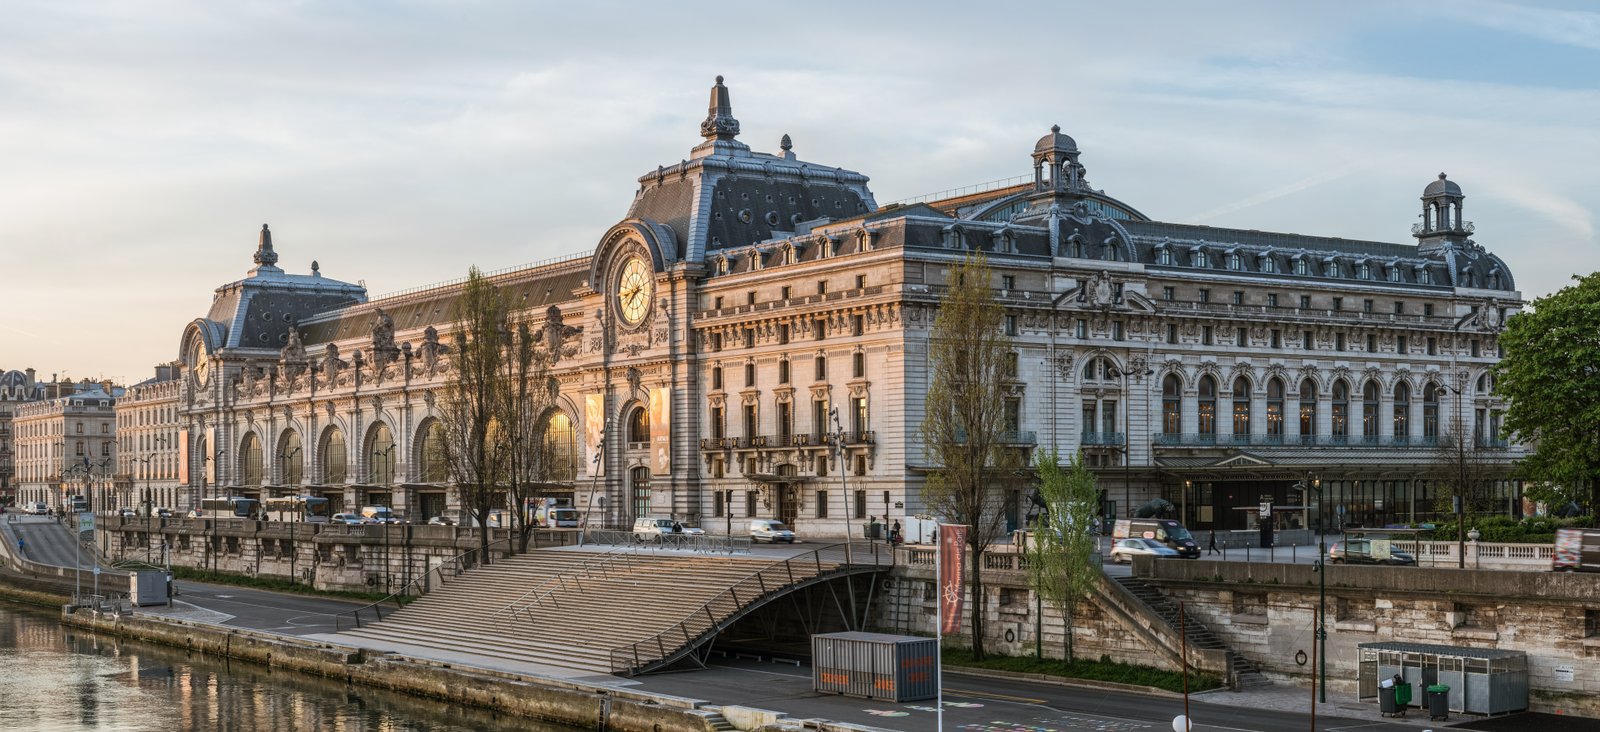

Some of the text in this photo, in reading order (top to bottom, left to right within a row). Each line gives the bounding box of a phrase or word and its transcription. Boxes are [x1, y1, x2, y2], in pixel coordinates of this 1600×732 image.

[953, 528, 963, 593] Marina de Paris
